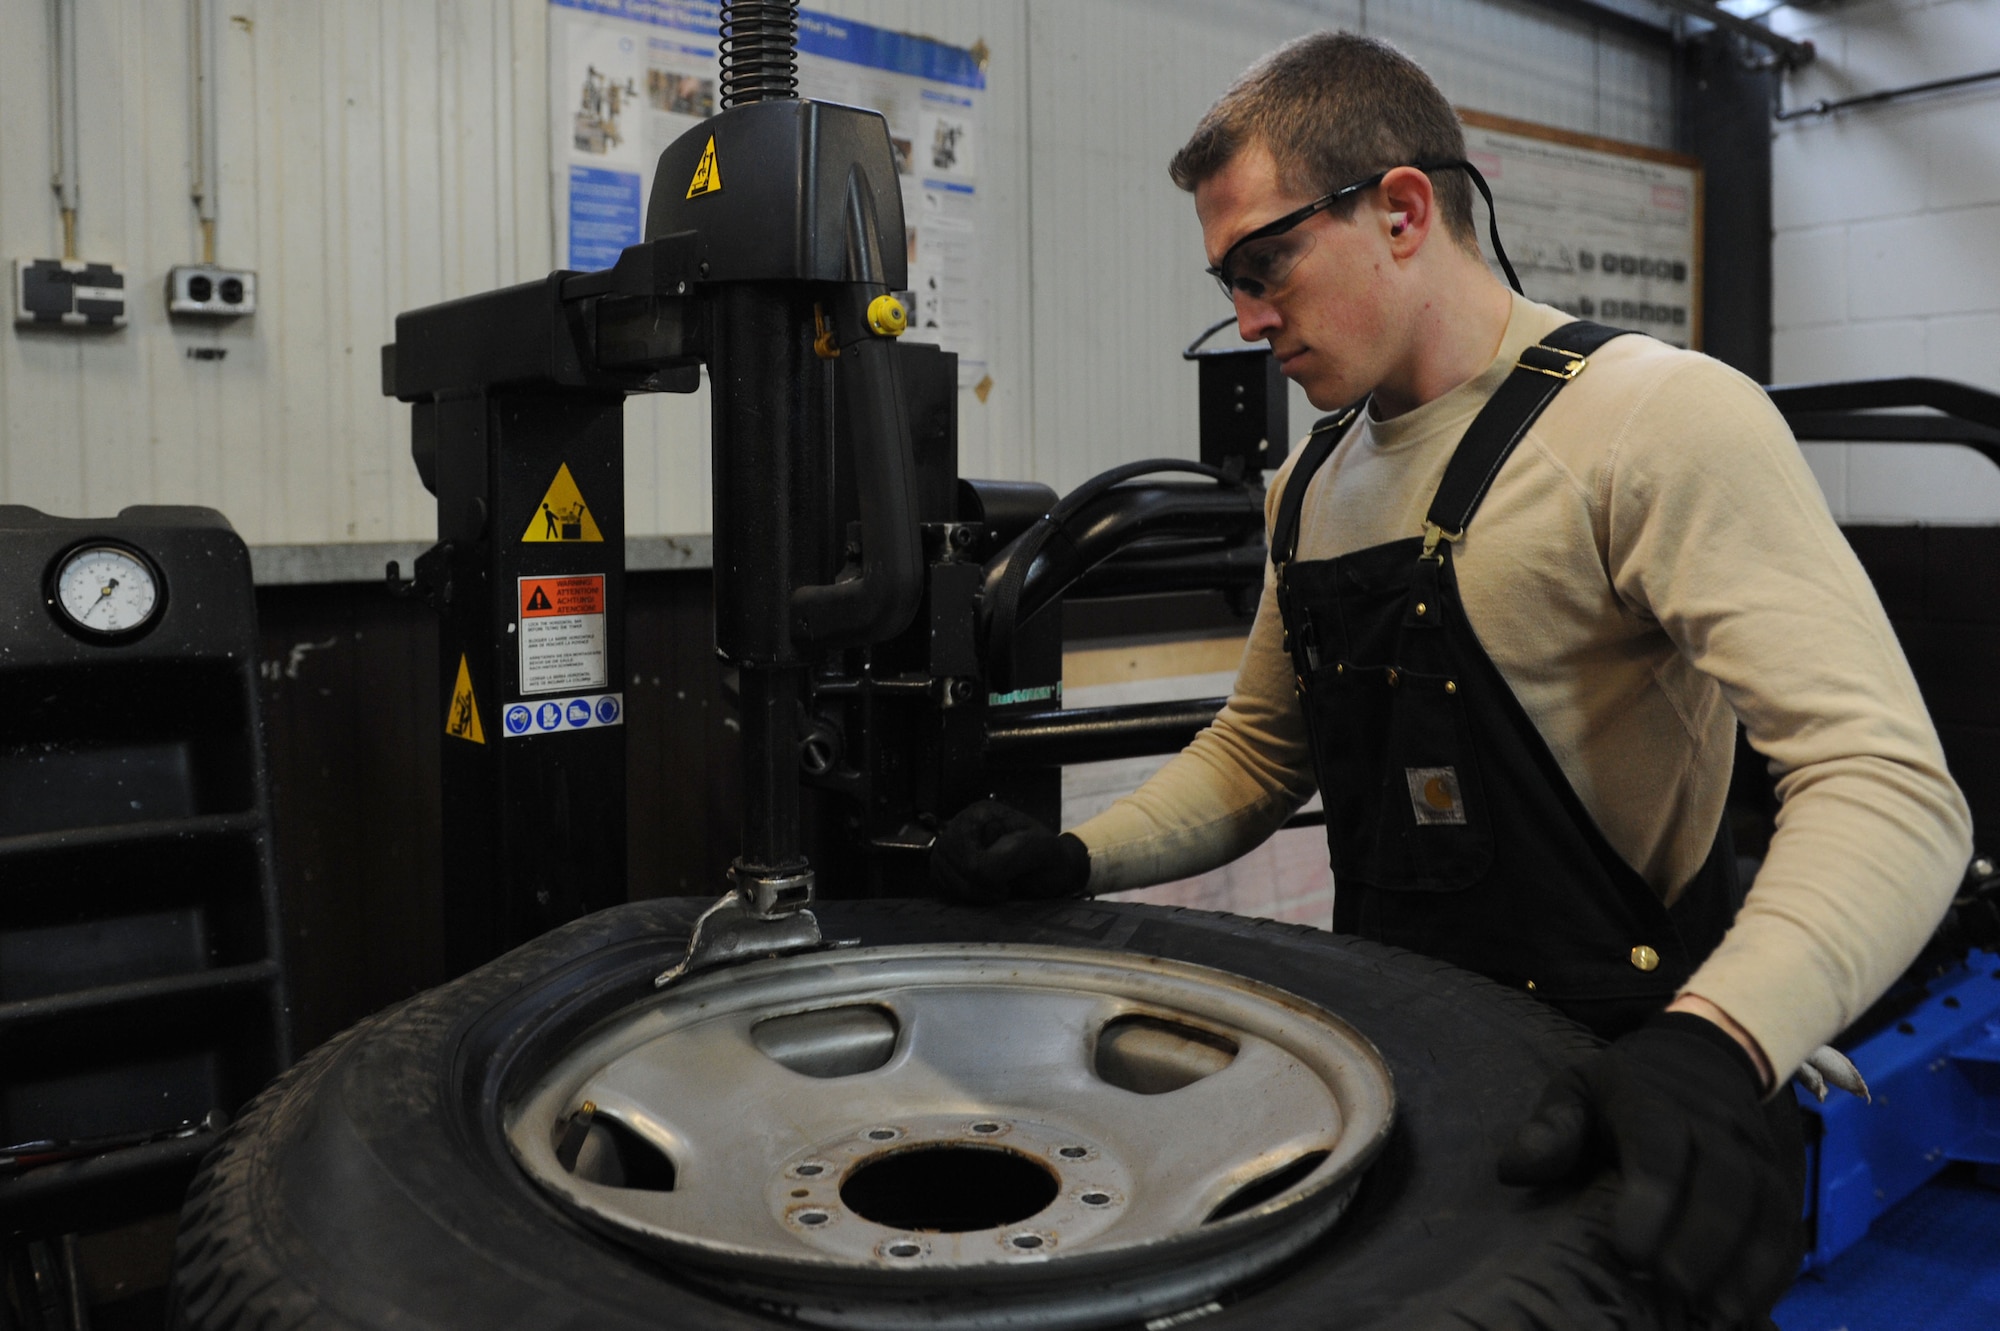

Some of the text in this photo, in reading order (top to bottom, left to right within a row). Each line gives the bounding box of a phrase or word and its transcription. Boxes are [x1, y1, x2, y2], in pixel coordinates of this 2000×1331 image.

[556, 579, 593, 587] WARNING!
[557, 587, 599, 596] ATTENTION!
[557, 596, 594, 605] ACHTUNG!
